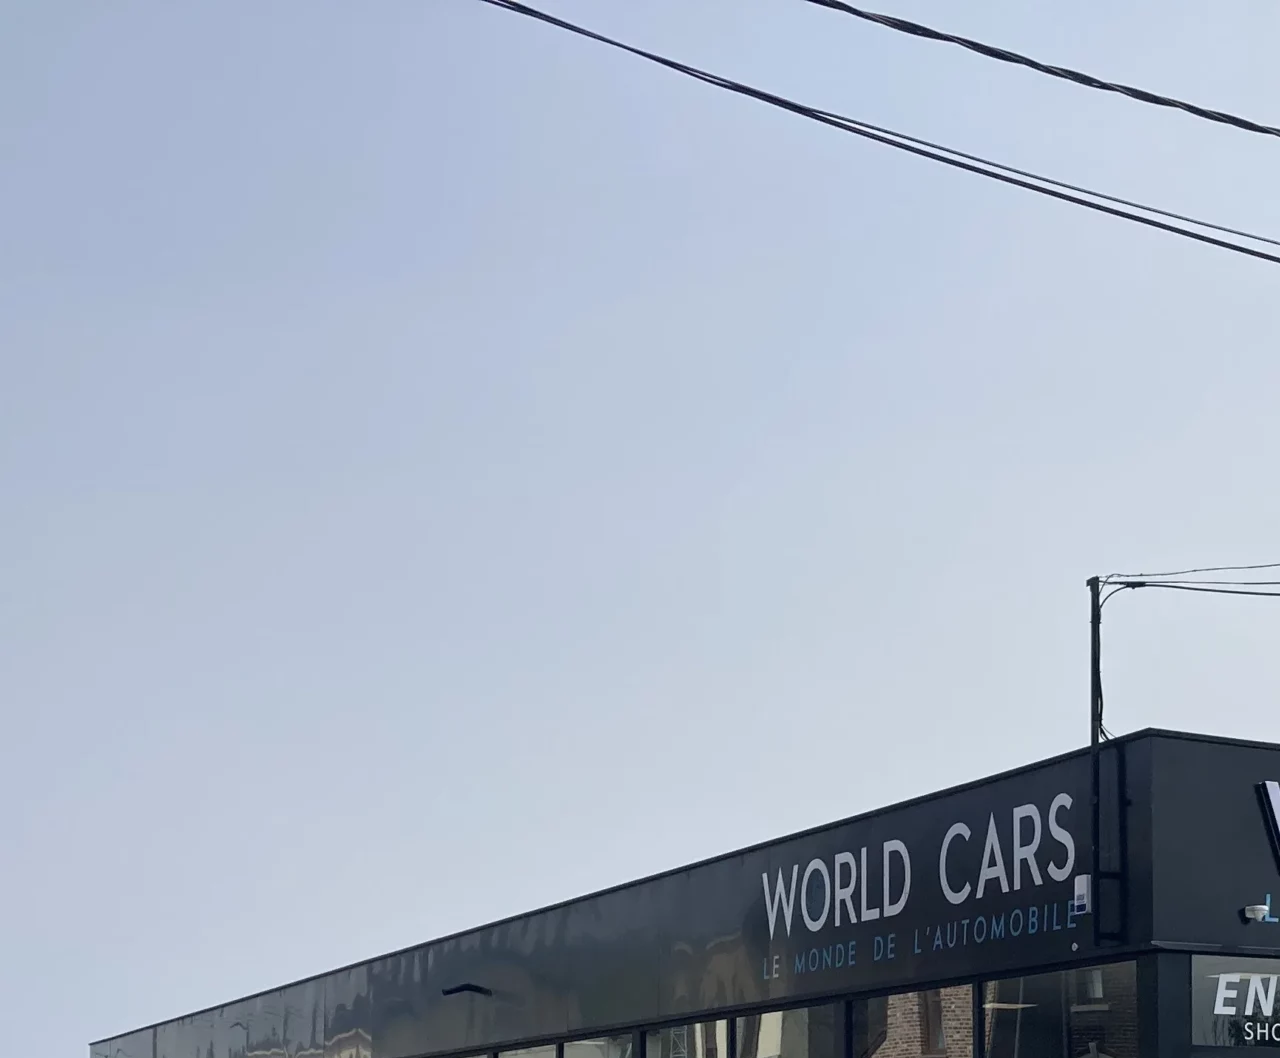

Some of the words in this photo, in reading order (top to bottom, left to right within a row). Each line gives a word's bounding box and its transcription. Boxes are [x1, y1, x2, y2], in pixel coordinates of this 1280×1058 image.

[762, 839, 911, 941] WORLD
[939, 793, 1076, 905] CARS
[763, 954, 780, 981] LE
[794, 940, 856, 975] MONDE
[873, 933, 896, 961] DE
[914, 900, 1078, 955] L'AUTOMOBILE
